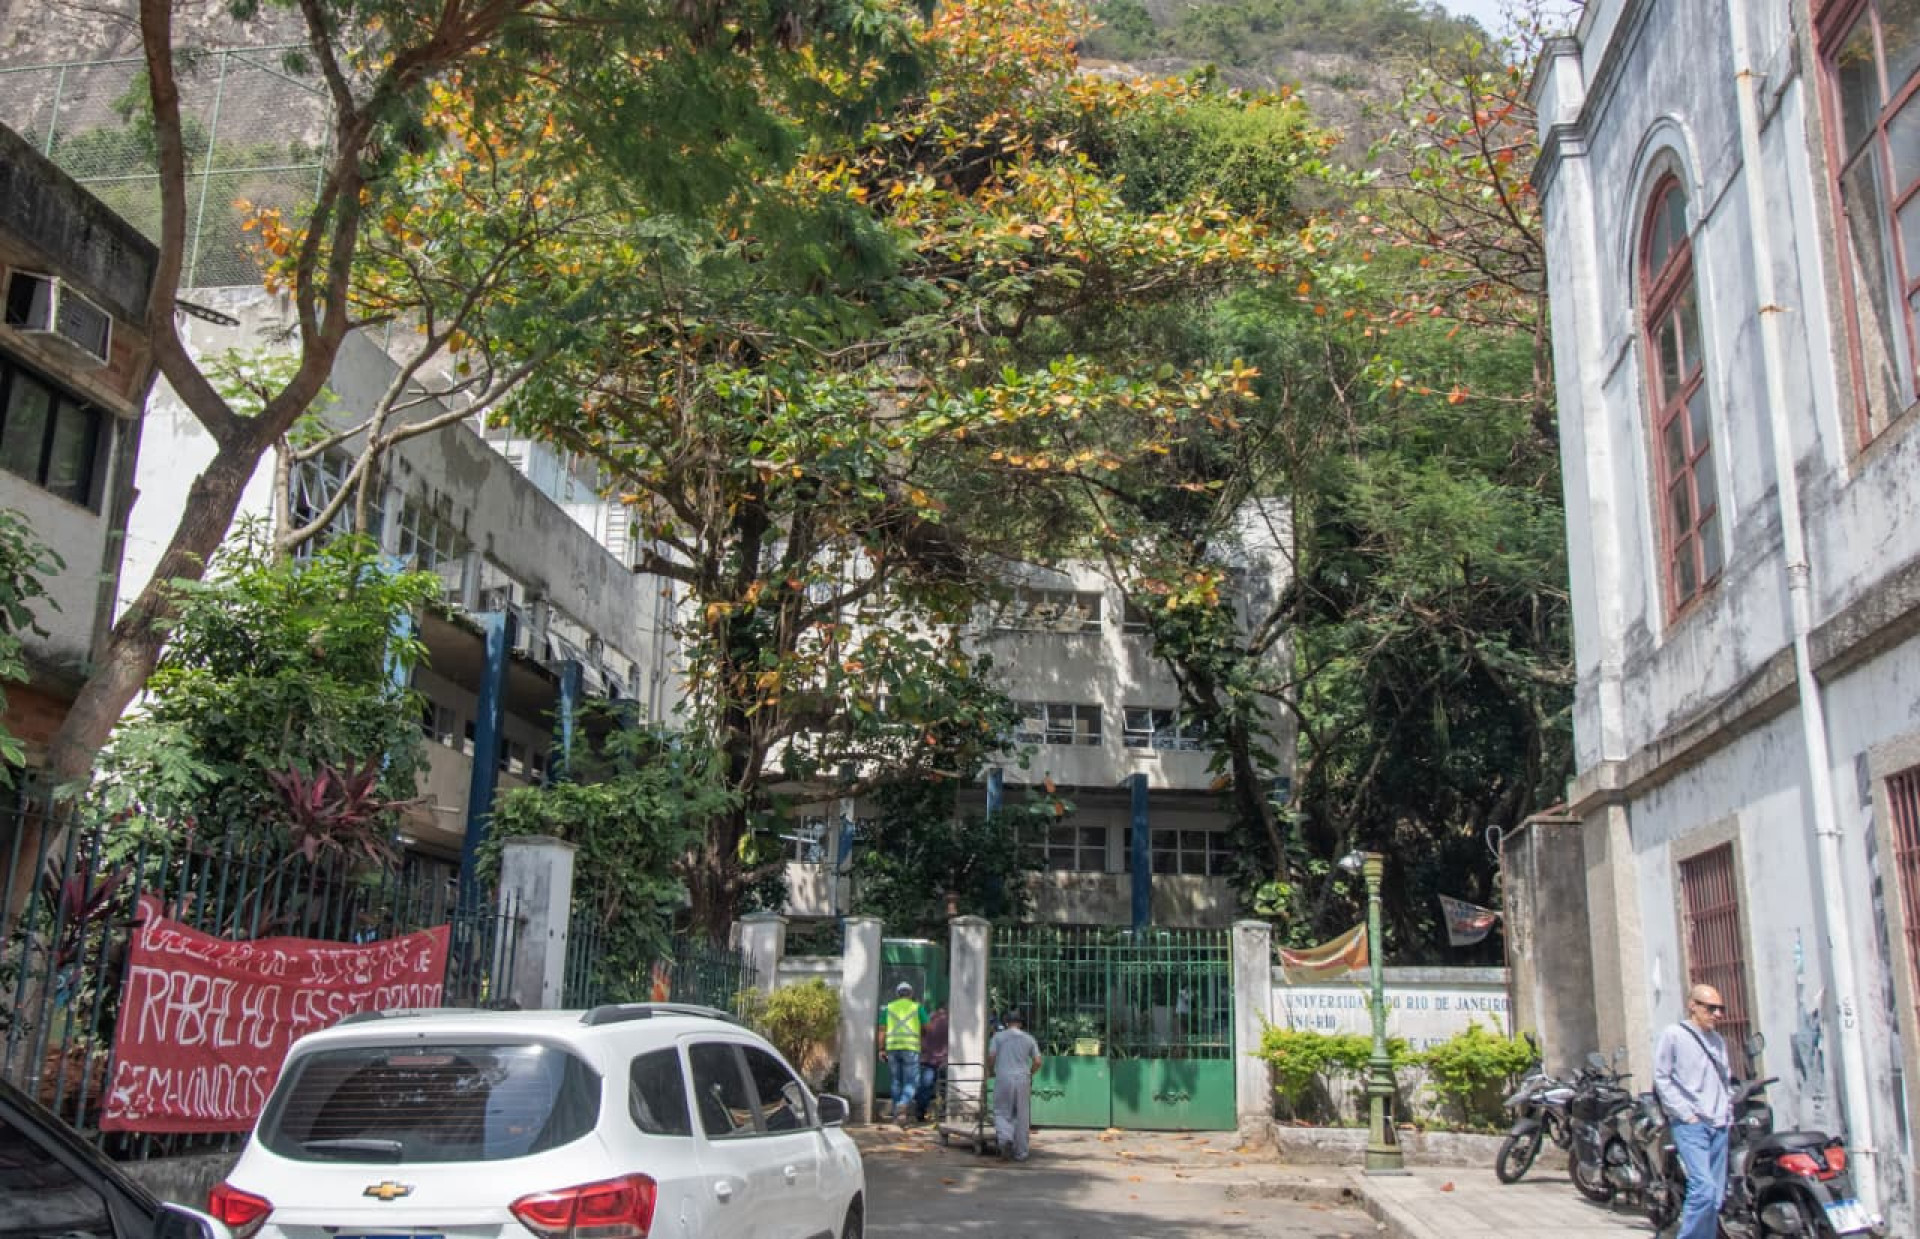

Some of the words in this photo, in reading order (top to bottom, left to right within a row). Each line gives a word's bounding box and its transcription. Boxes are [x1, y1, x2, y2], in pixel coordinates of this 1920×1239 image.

[121, 966, 281, 1049] TRABALHO
[1406, 995, 1429, 1009] RIO
[1435, 996, 1450, 1010] DE
[1455, 996, 1508, 1011] JANEIRO
